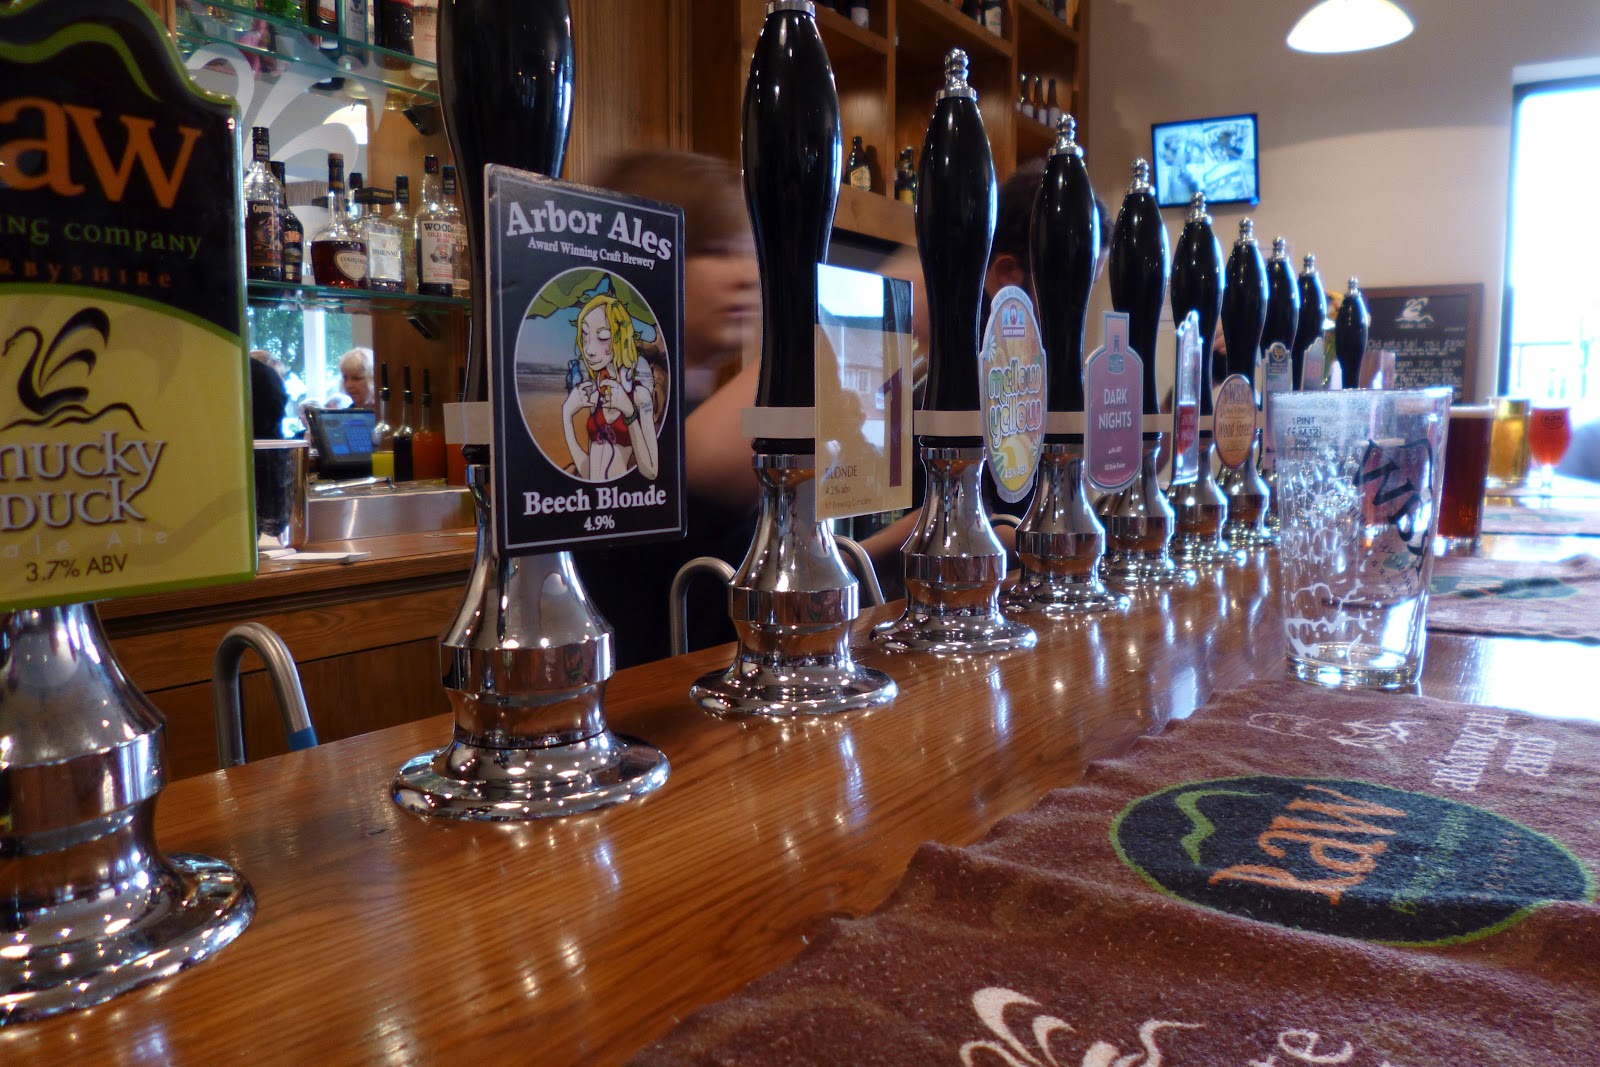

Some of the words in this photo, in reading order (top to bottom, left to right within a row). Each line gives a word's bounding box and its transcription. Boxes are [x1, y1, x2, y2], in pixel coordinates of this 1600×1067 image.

[506, 200, 602, 237] Arbor
[607, 211, 673, 261] Ales
[528, 236, 559, 252] Award
[559, 242, 598, 261] Winning
[599, 250, 622, 262] Craft
[622, 252, 655, 270] Brewery
[1103, 388, 1128, 405] DARK
[1098, 411, 1132, 430] NIGHTS
[825, 465, 858, 480] BLONDE
[522, 487, 592, 516] Beech
[596, 485, 667, 511] Blonde
[583, 514, 616, 532] 4.9%
[25, 559, 81, 583] 3.7%
[86, 553, 129, 577] ABV
